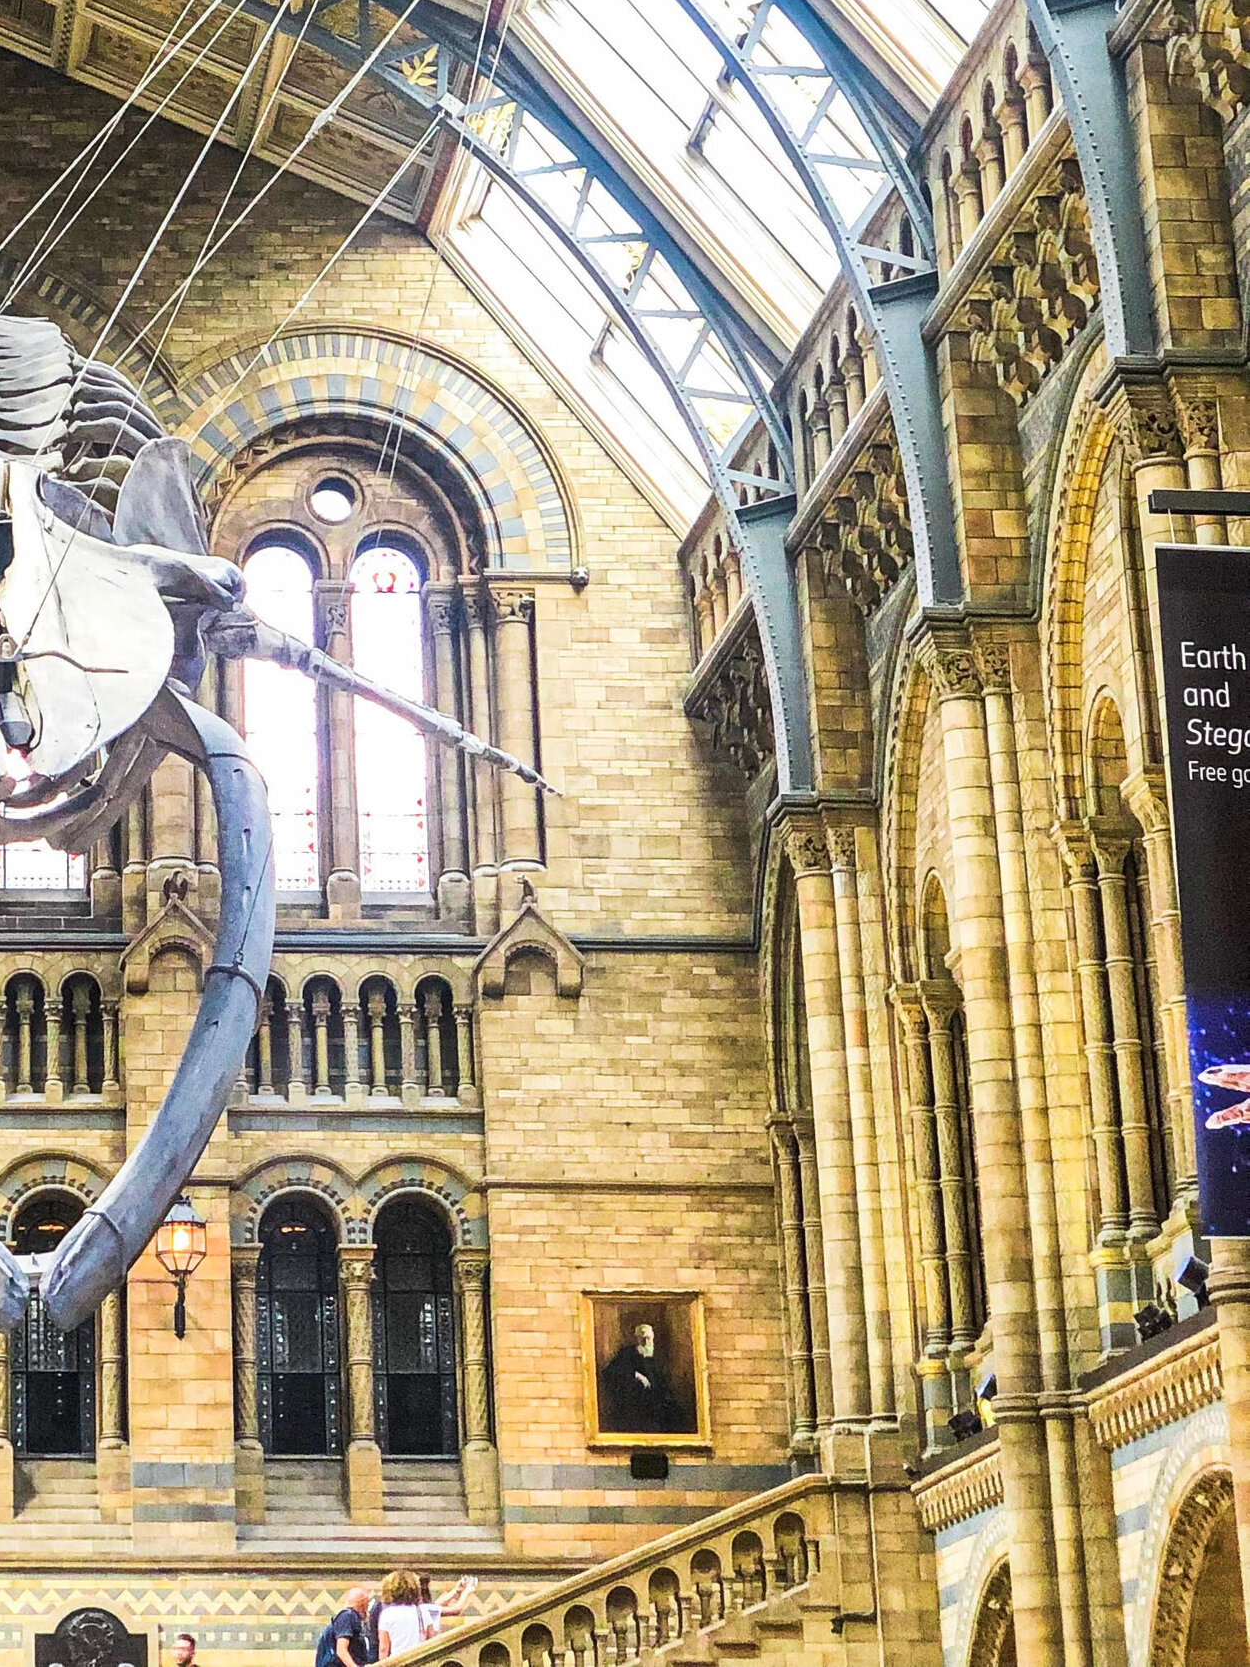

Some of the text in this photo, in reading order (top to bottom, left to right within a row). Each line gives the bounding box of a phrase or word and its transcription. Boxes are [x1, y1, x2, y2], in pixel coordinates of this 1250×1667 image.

[1180, 641, 1247, 671] Earth
[1183, 681, 1231, 708] and
[1188, 760, 1227, 782] Free
